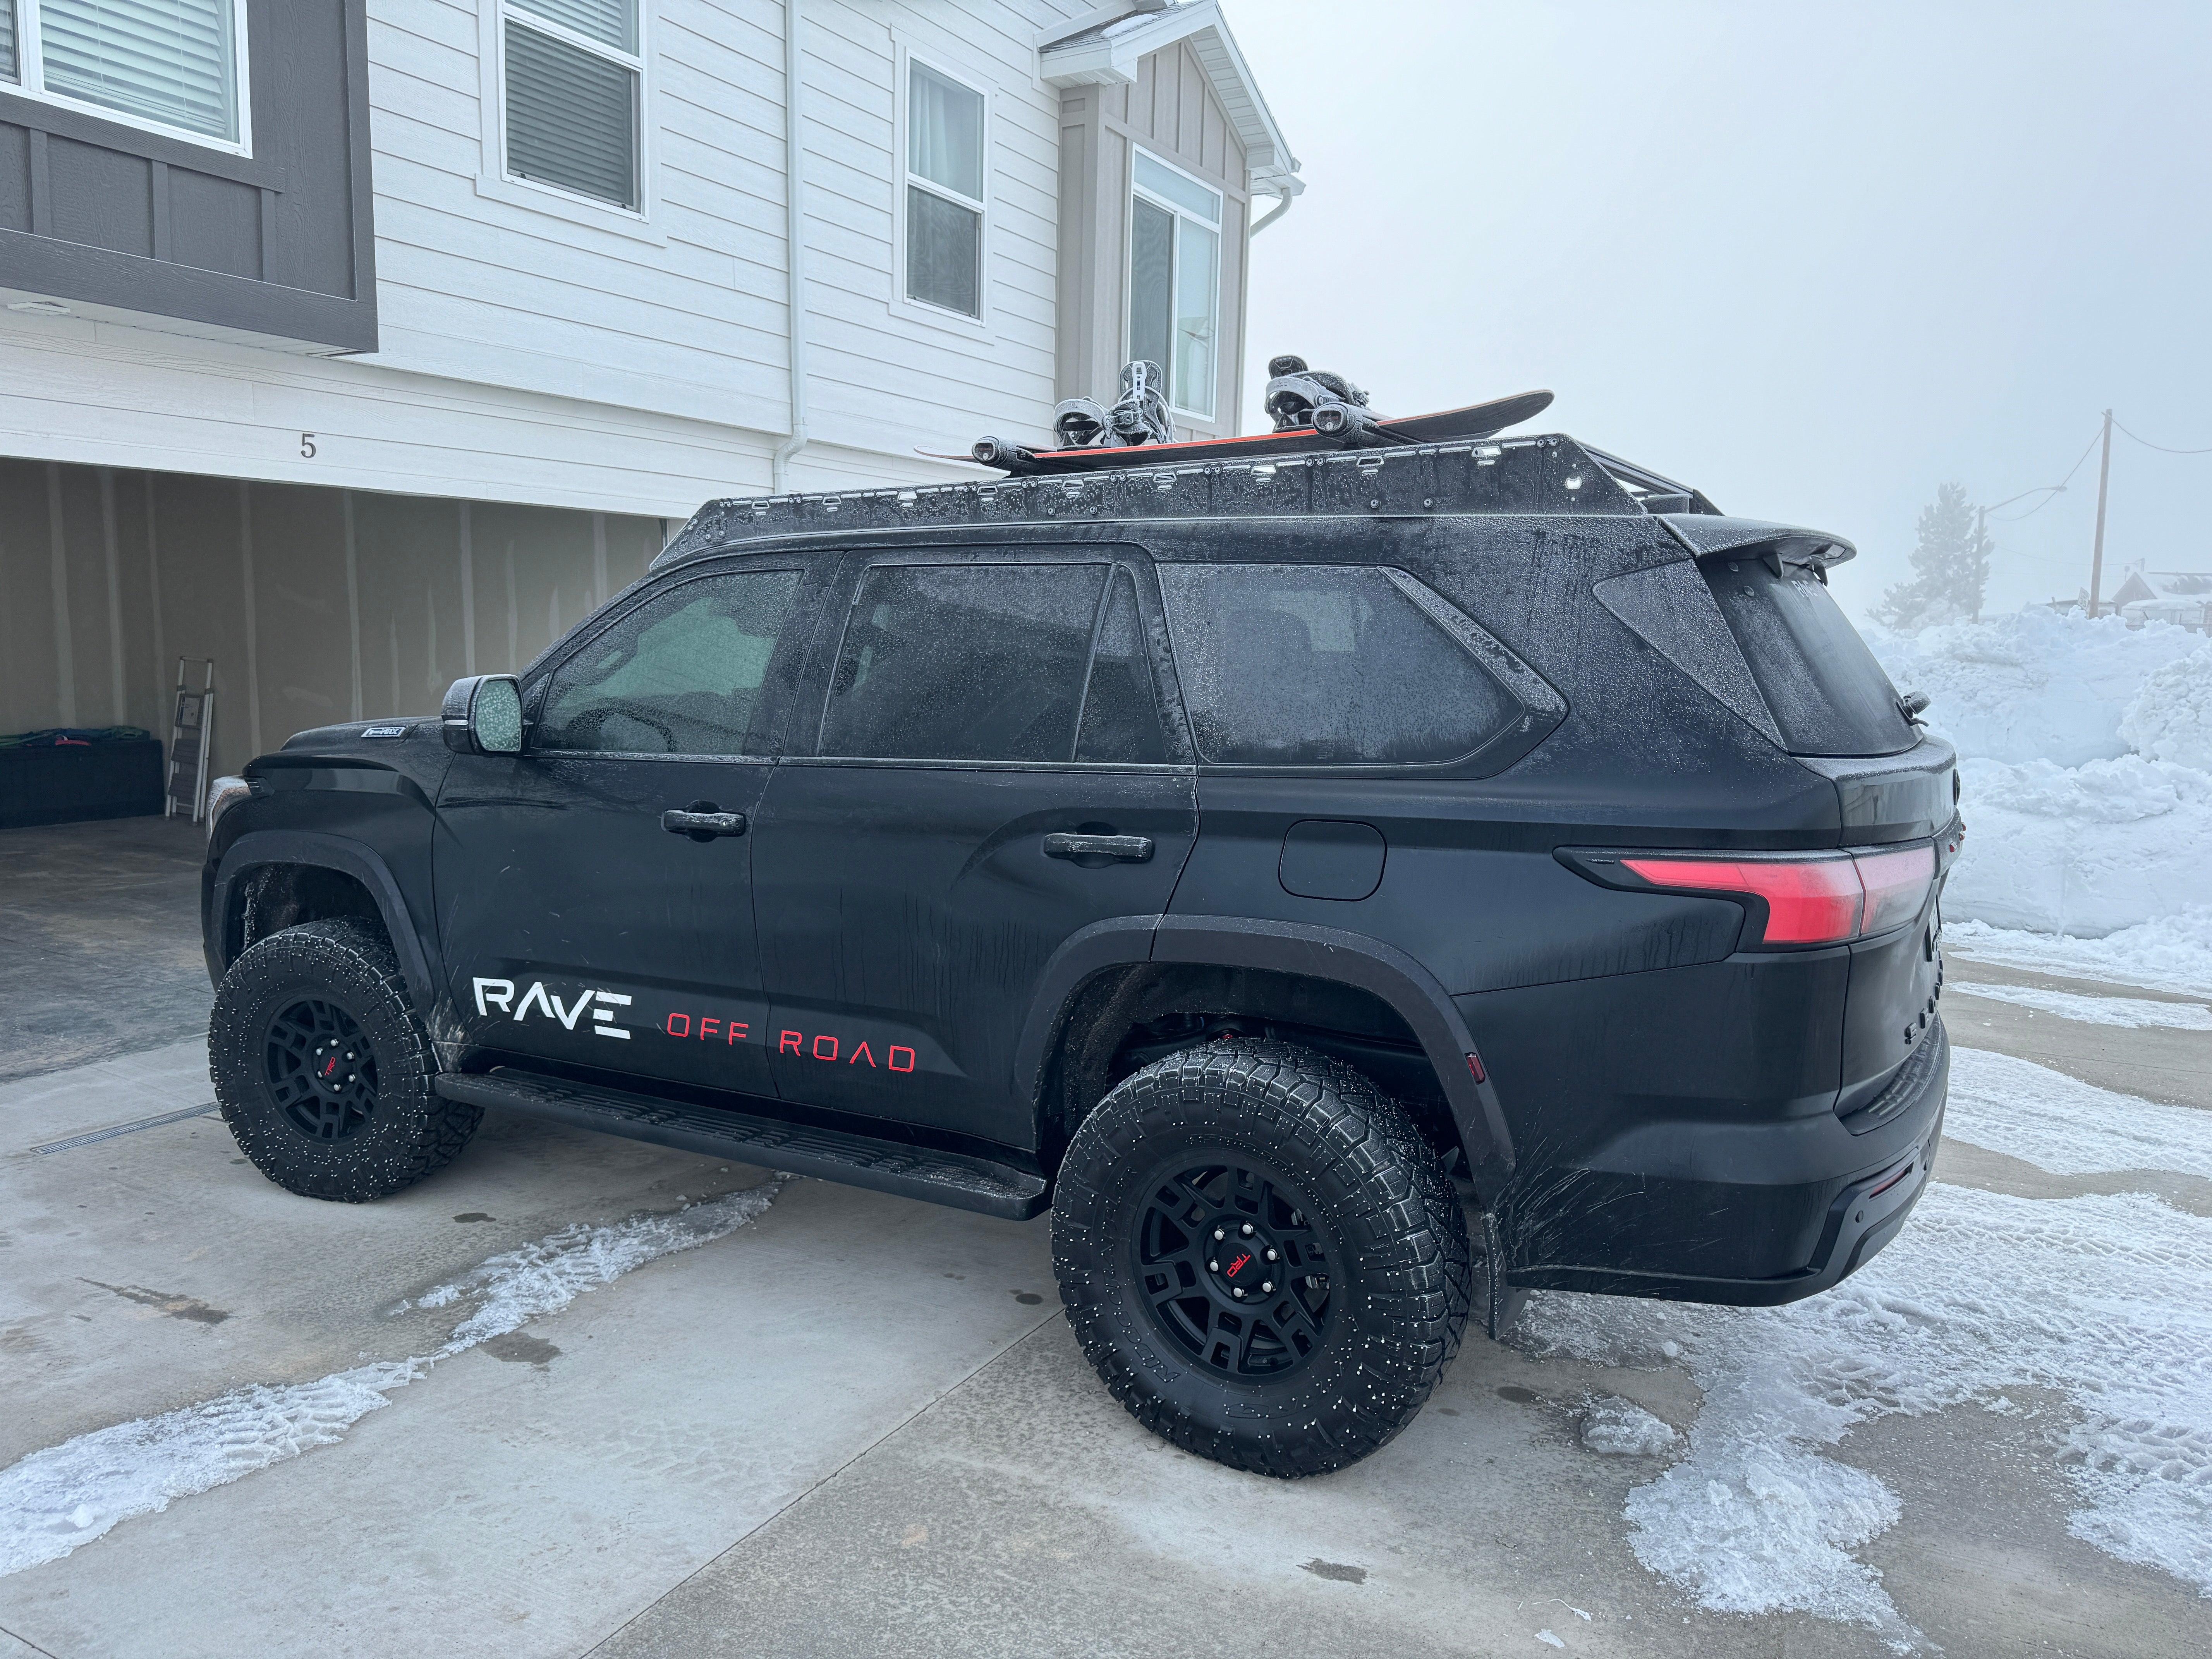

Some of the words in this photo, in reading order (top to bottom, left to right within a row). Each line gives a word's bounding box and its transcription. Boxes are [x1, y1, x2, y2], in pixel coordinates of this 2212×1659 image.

[301, 433, 316, 458] 5
[473, 977, 632, 1039] RAVE
[667, 1013, 749, 1045] OFF
[779, 1030, 915, 1072] ROAD
[325, 1057, 335, 1076] TRD
[1227, 1253, 1251, 1277] TRD
